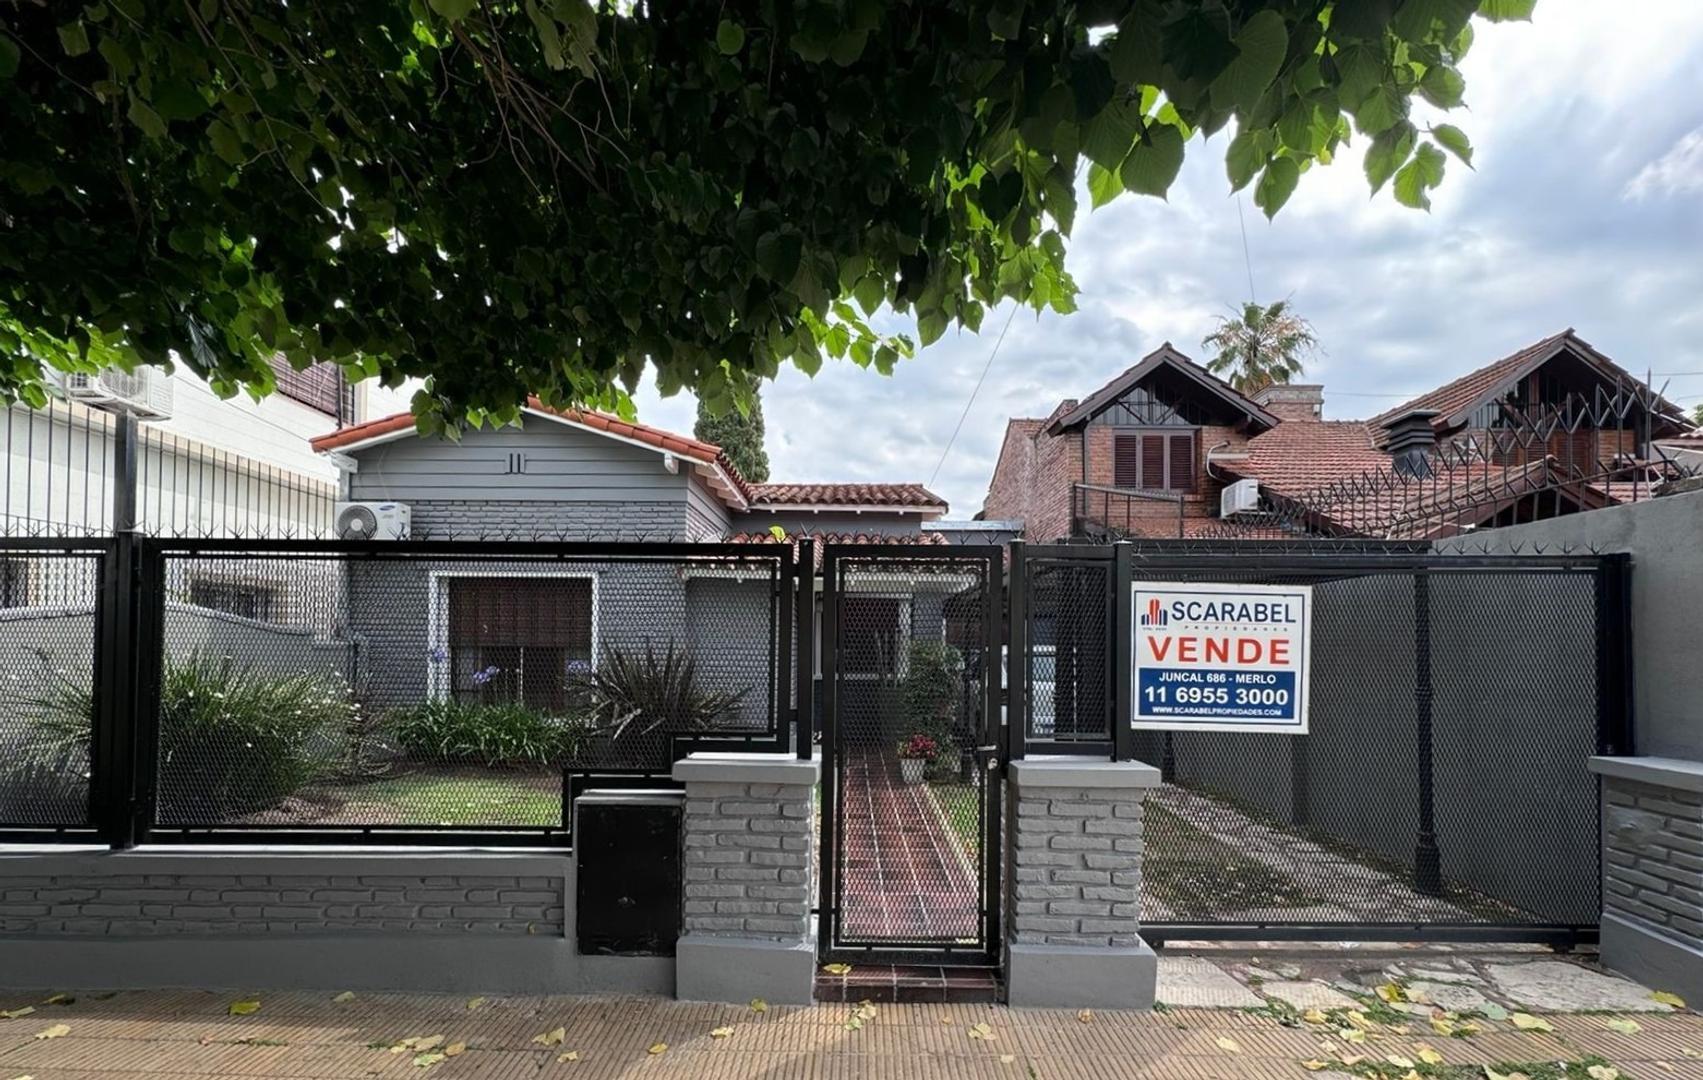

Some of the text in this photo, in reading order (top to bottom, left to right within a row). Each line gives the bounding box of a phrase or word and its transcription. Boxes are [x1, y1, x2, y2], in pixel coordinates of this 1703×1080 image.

[1171, 600, 1297, 623] SCARABEL
[1148, 635, 1290, 665] VENDE
[1158, 672, 1204, 683] JUNCAL
[1235, 673, 1276, 685] MERLO
[1145, 686, 1288, 705] 11 6955 3000
[1152, 706, 1282, 716] WWW.SCARABELPROPIEDADES.COM
